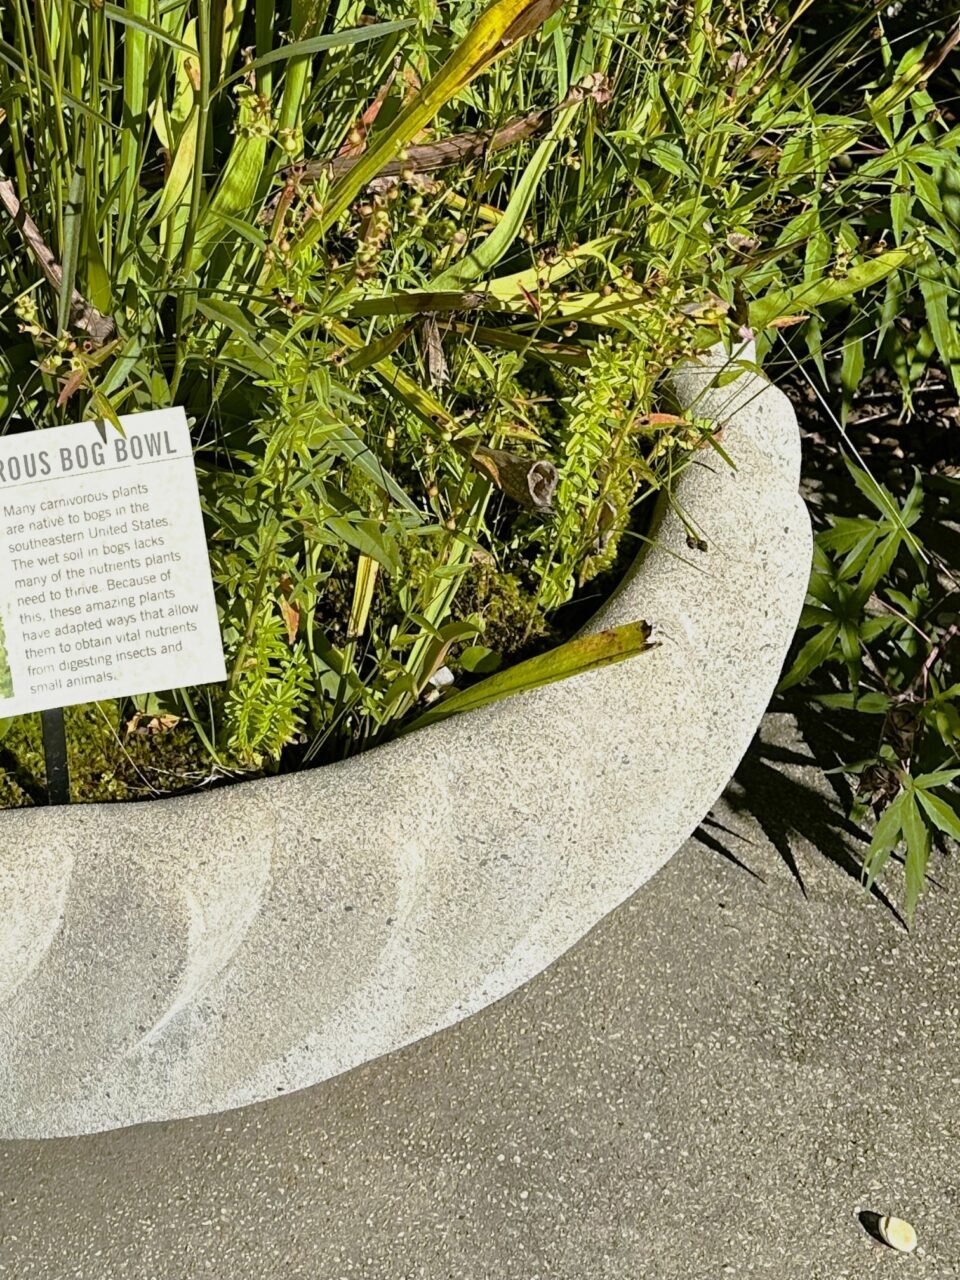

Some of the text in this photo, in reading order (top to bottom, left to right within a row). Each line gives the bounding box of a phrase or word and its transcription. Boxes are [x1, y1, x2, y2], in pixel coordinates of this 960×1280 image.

[60, 441, 106, 472] BOG
[114, 430, 177, 461] BOWL
[3, 484, 148, 518] Many carnivorous plants
[6, 502, 149, 535] are native to bogs in the
[9, 517, 172, 553] southeastern United States.
[12, 536, 164, 571] The wet soil in bogs lacks
[15, 551, 181, 588] many of the nutrients plants
[18, 569, 172, 607] need to thrive. Because of
[20, 588, 175, 625] this, these amazing plants
[23, 602, 199, 642] have adapted ways that allow
[25, 621, 197, 659] them to obtain vital nutrients
[27, 641, 183, 677] from digesting insects and
[30, 672, 117, 695] small animals.
